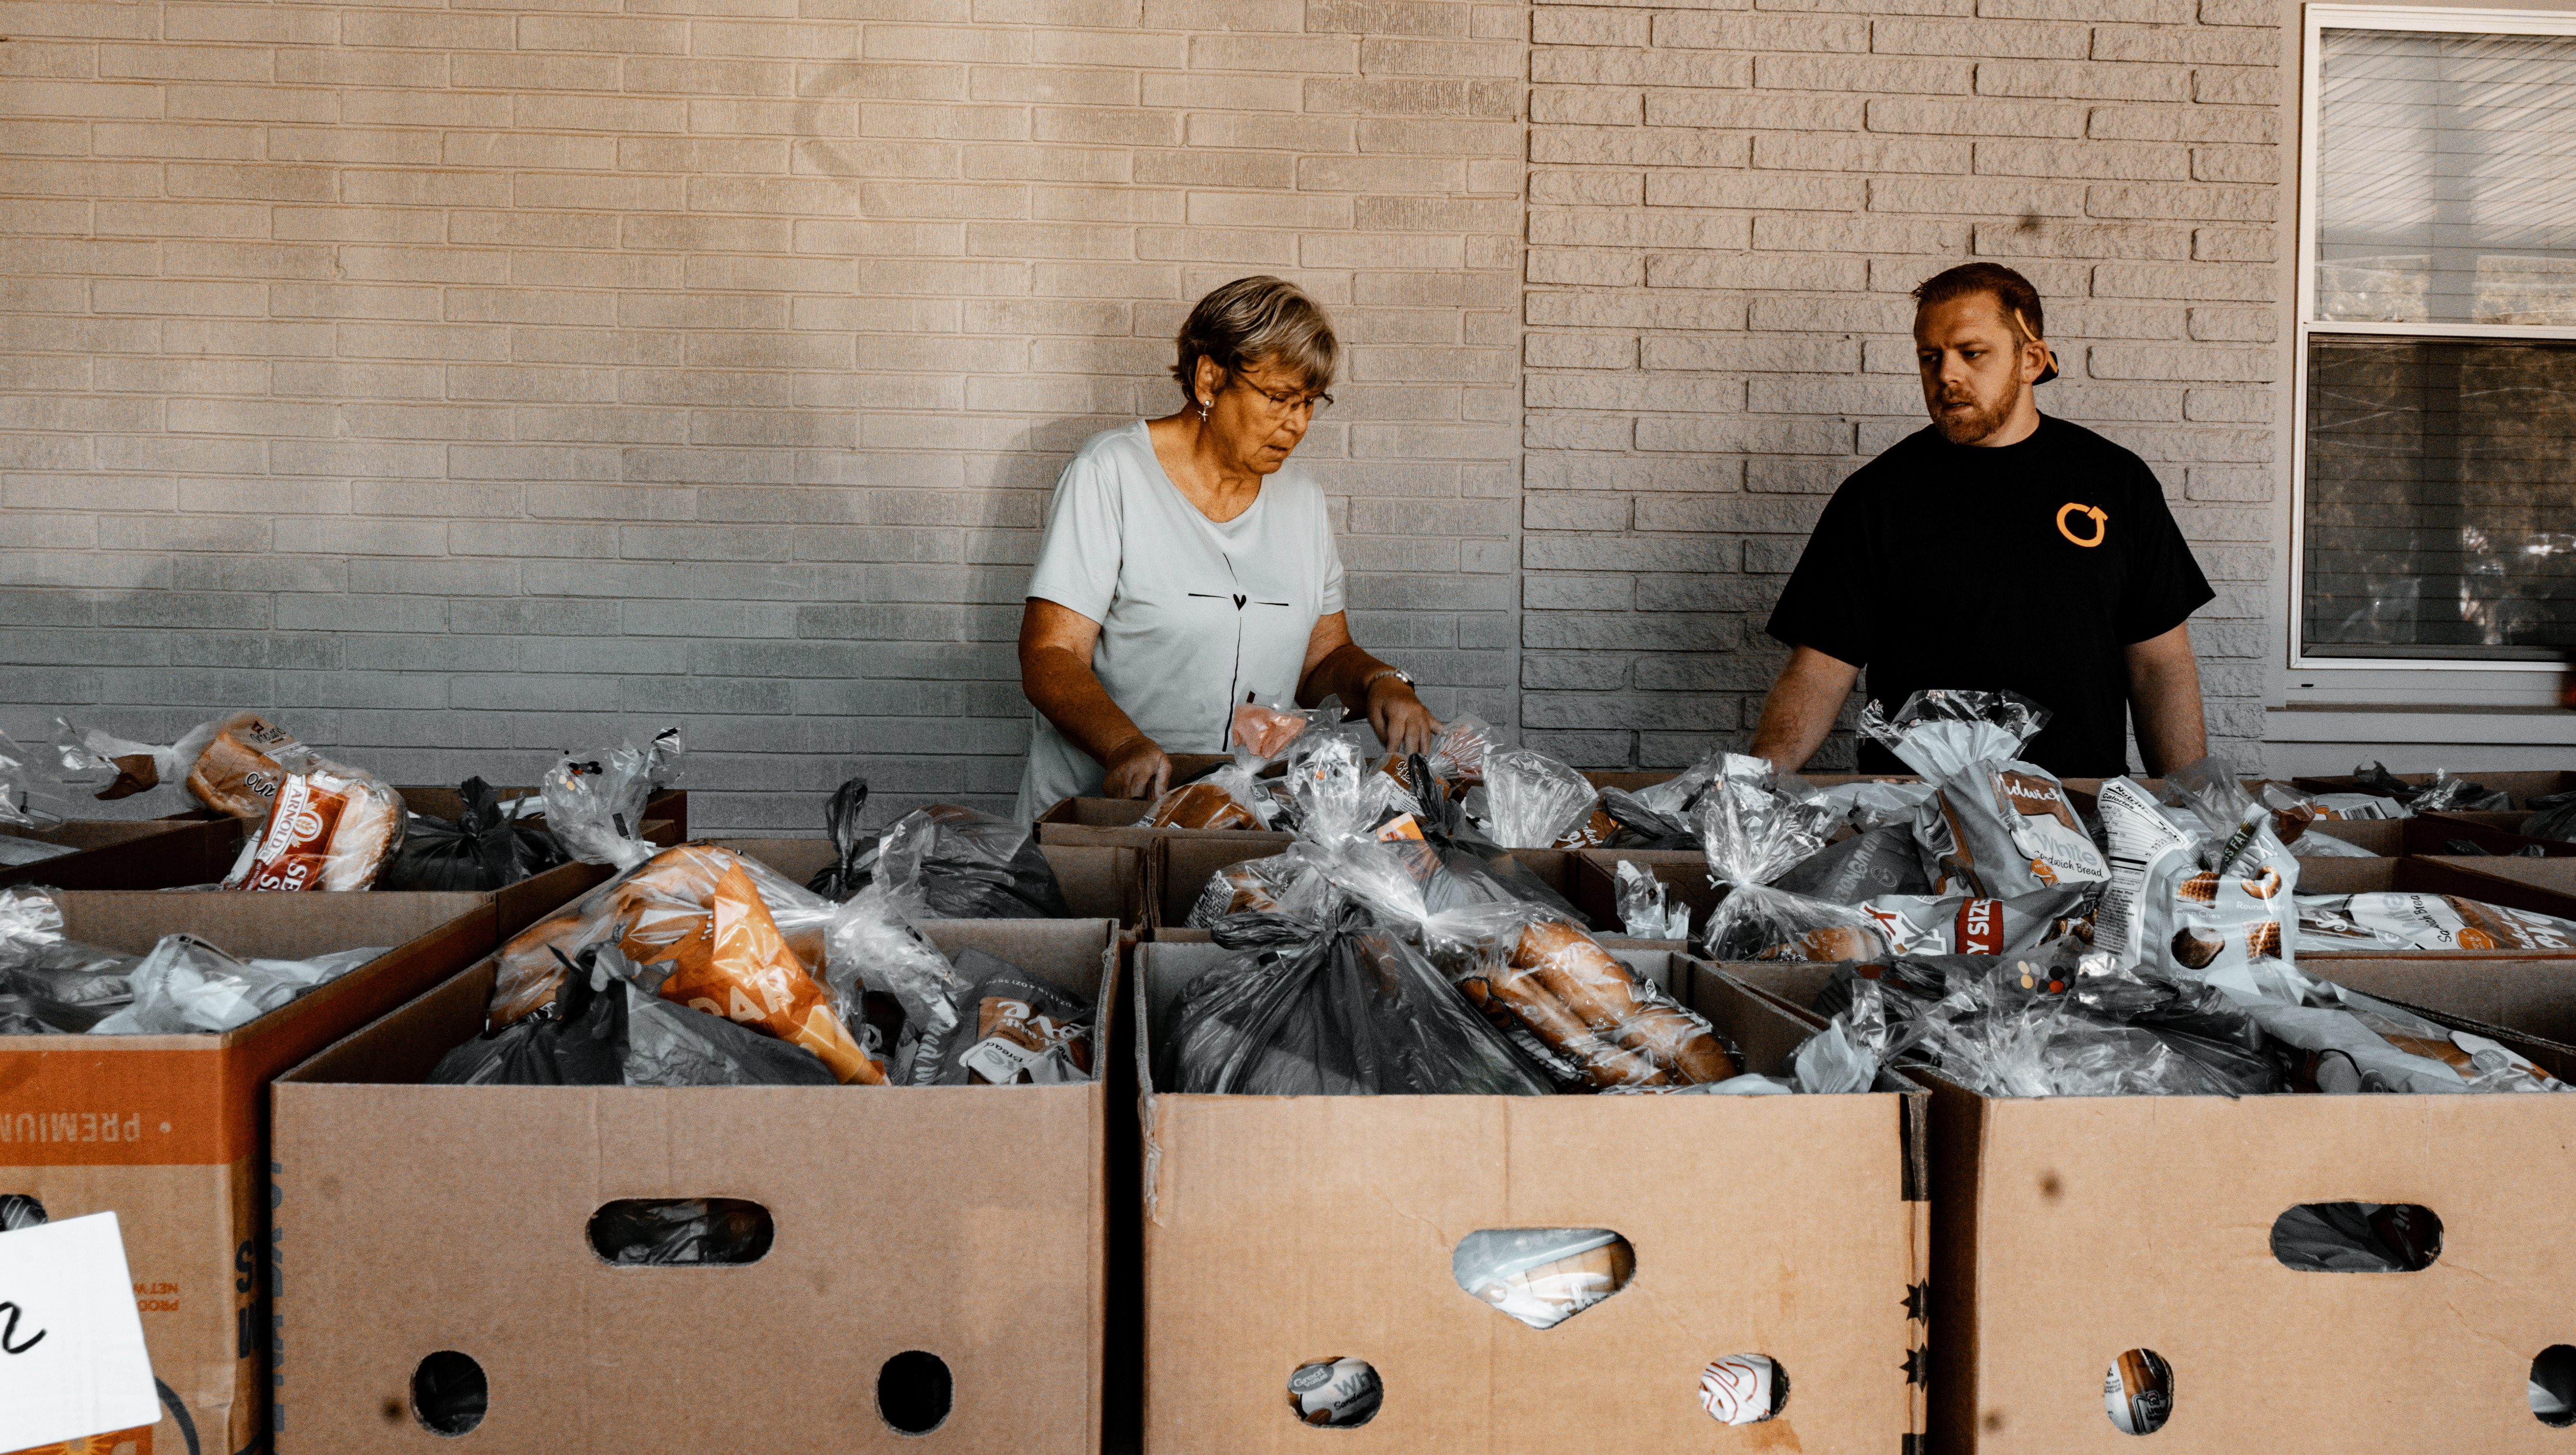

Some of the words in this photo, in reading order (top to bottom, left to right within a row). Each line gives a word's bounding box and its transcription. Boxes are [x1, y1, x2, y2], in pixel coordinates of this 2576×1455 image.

[2102, 793, 2135, 810] Calories
[269, 788, 303, 849] ARNOLD
[2032, 832, 2098, 867] White
[2230, 828, 2250, 851] FAT
[2230, 834, 2279, 879] MIX!
[2075, 862, 2103, 878] Bread
[2175, 908, 2197, 916] Corn
[2236, 901, 2265, 911] Round
[2410, 895, 2426, 916] Brea
[1967, 897, 1992, 936] SIZE
[984, 1041, 1024, 1063] Bread
[137, 1298, 179, 1312] PROD
[1293, 1368, 1326, 1387] Great
[1304, 1373, 1328, 1387] Value
[1333, 1386, 1377, 1410] Sandwich
